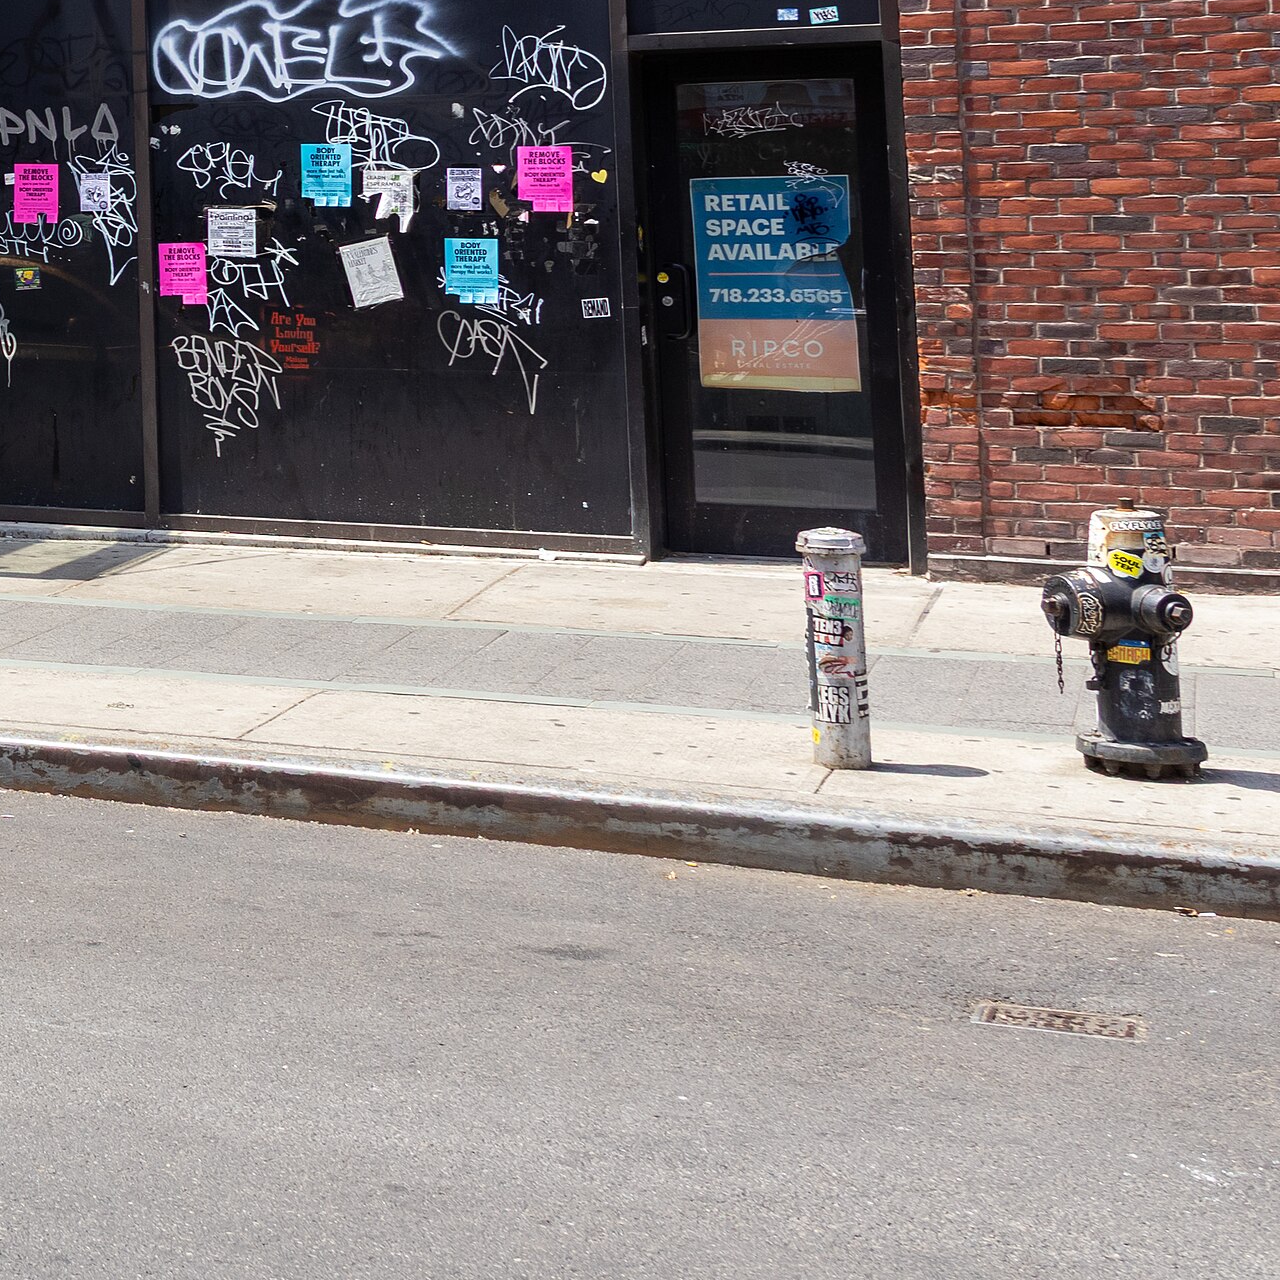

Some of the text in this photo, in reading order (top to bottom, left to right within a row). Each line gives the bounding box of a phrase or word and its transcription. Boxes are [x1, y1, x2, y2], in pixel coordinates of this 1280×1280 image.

[704, 194, 790, 212] RETAIL
[706, 218, 785, 237] SPACE
[708, 243, 839, 262] AVAILABLE
[709, 288, 842, 304] 718.233.6565
[271, 311, 316, 326] Are You
[275, 327, 313, 341] Loving
[732, 339, 824, 357] RIPCO
[1113, 554, 1141, 569] SOUL
[1115, 561, 1133, 572] TEK
